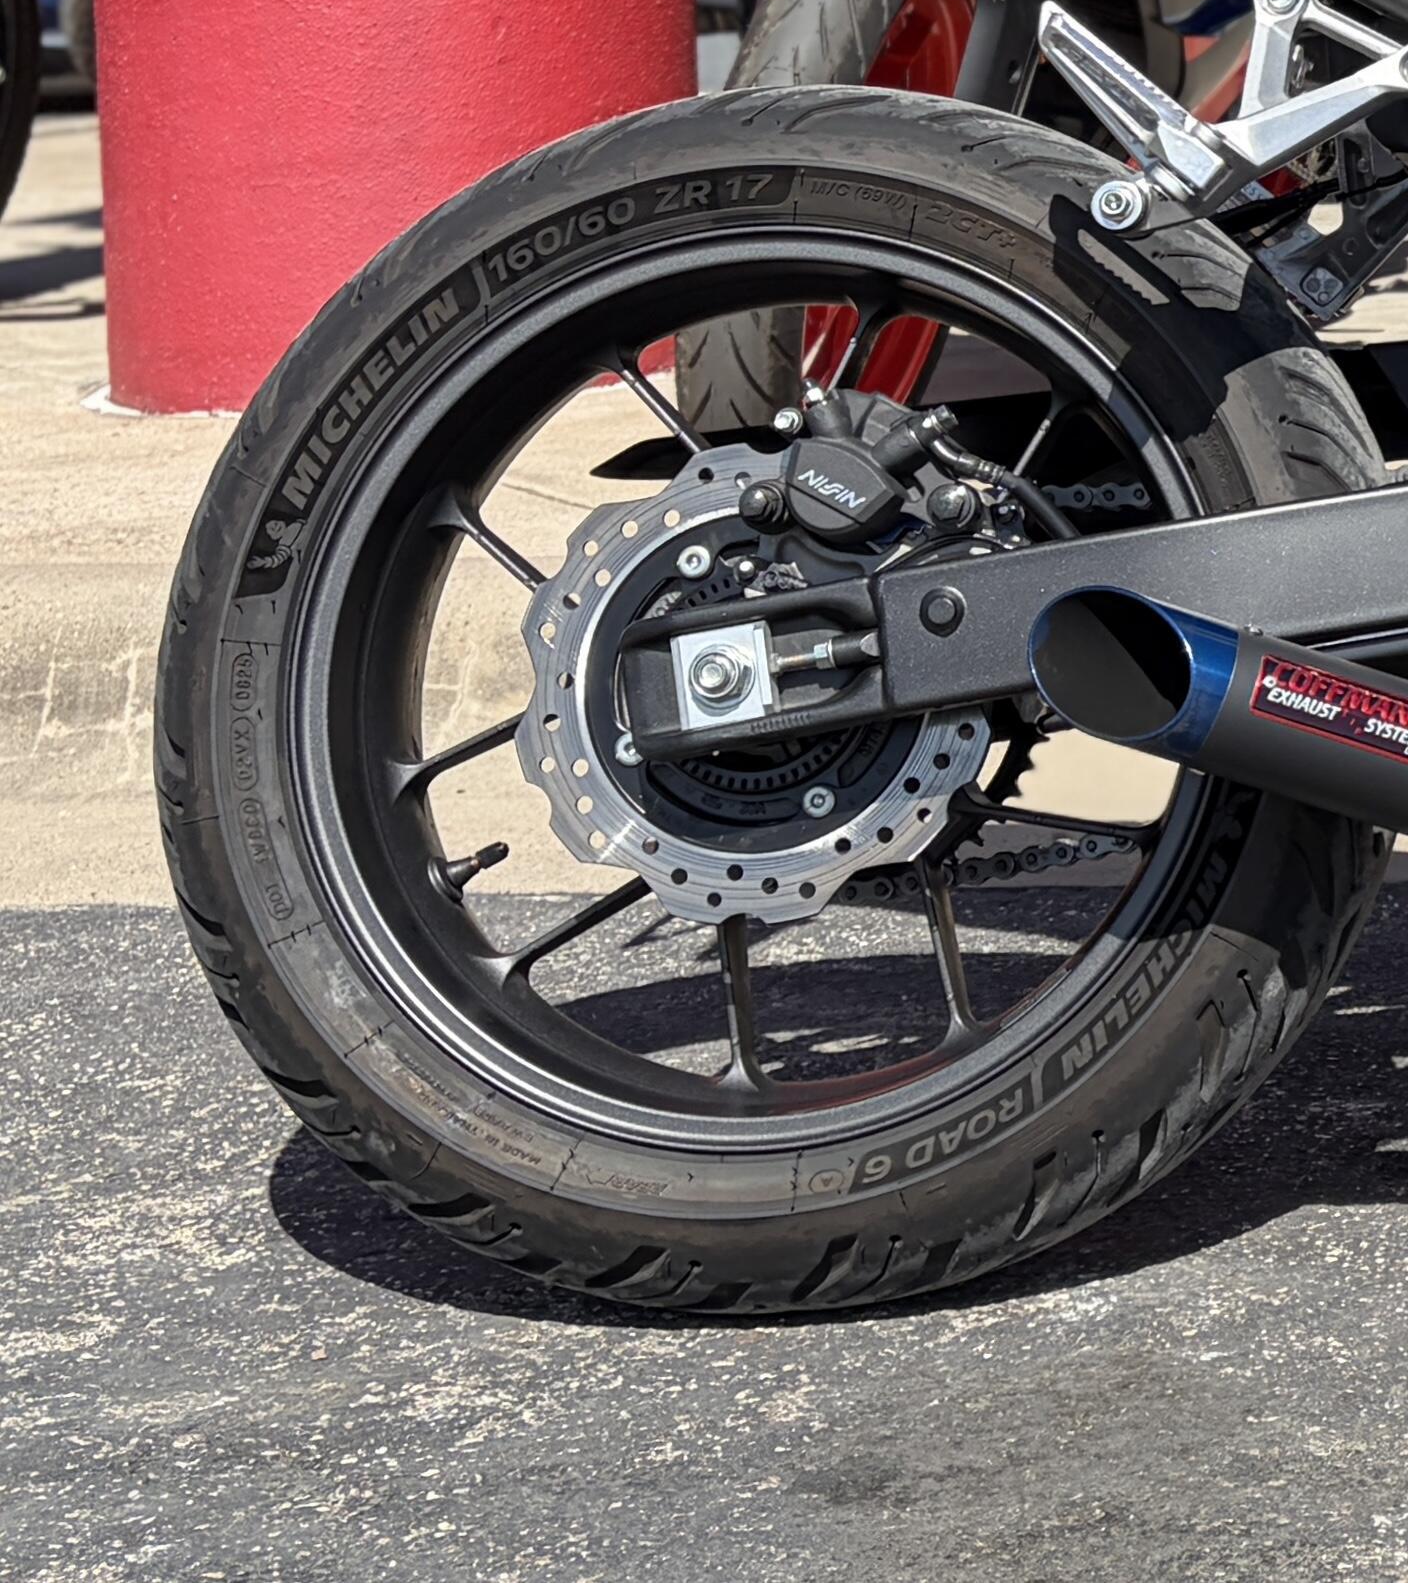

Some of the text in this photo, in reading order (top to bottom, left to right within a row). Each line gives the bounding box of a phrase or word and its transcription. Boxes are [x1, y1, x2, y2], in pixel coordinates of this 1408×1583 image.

[281, 173, 773, 510] MICHELIN 160/60 ZR 17
[1267, 687, 1341, 721] EXHAUST
[862, 852, 1228, 1184] MICHELIN ROAD 6
